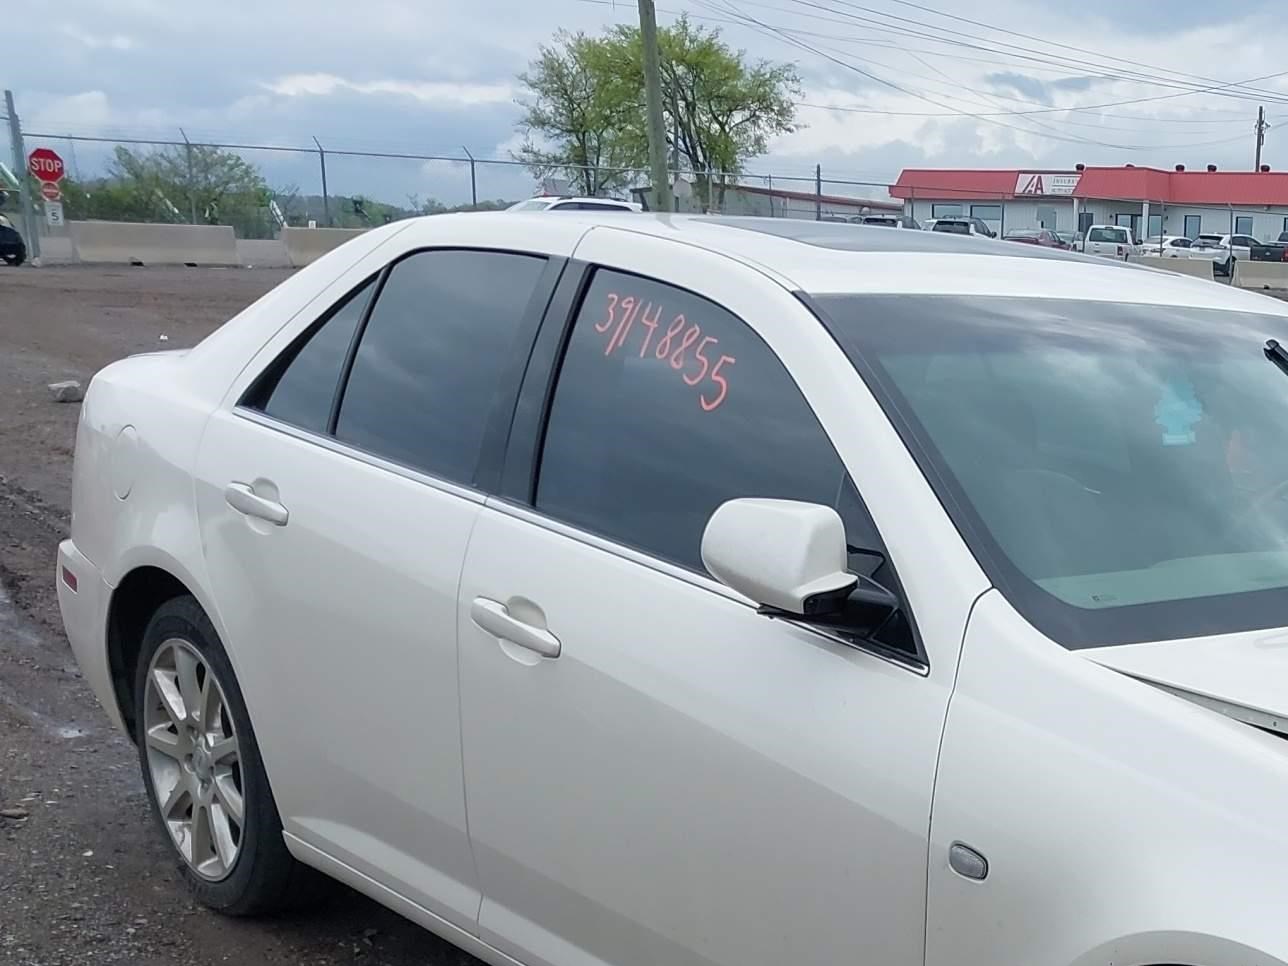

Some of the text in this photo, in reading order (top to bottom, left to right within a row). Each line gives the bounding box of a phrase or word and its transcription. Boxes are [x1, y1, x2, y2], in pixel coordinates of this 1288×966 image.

[31, 158, 62, 173] STOP
[51, 210, 59, 221] 5
[594, 293, 736, 412] 39148855
